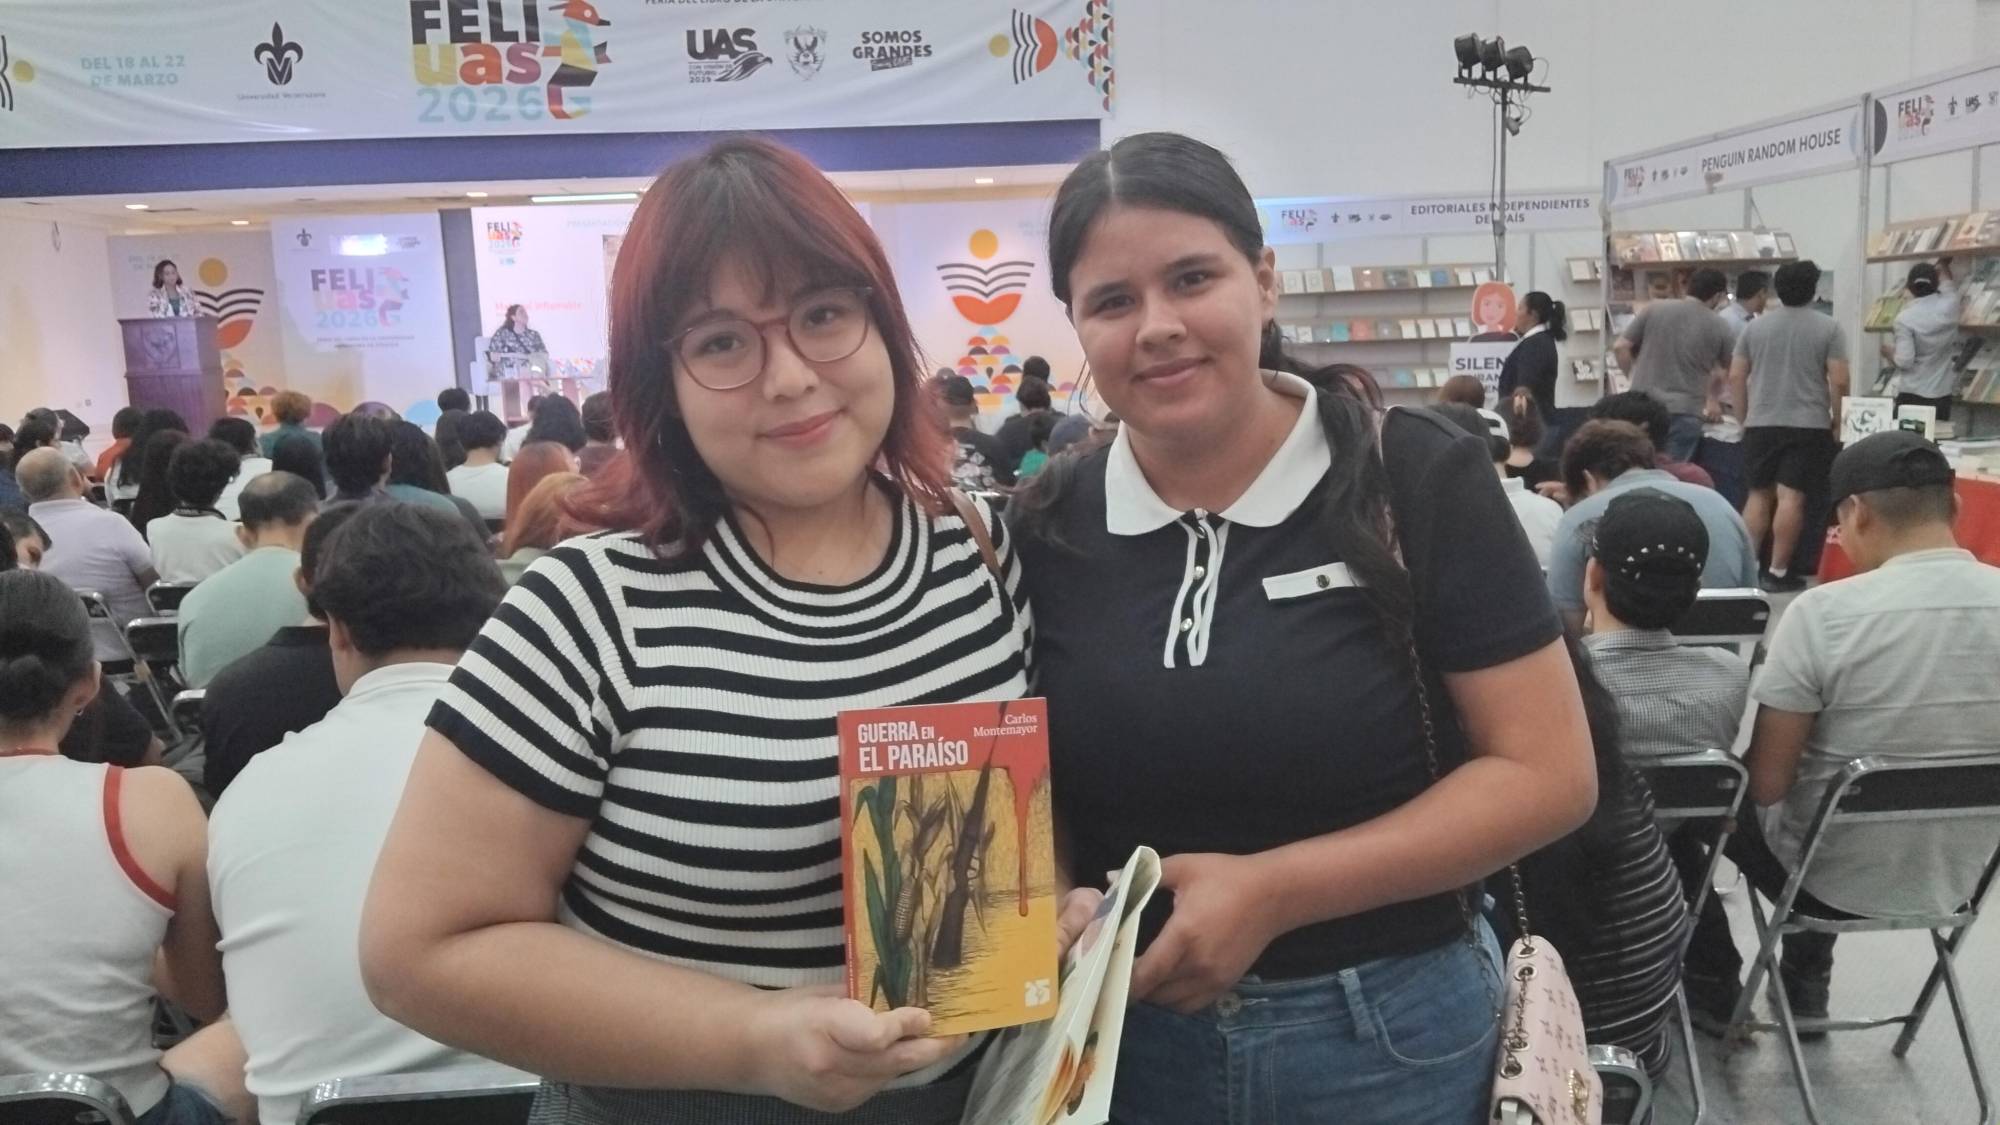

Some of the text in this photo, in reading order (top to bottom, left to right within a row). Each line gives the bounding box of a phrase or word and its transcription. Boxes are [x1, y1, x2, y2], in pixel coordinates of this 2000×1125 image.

[410, 0, 540, 45] FELI
[686, 28, 757, 60] UAS
[861, 30, 922, 44] SOMOS
[852, 44, 933, 59] GRANDES
[81, 54, 185, 70] DEL 18 AL 22
[412, 43, 542, 86] uas
[91, 73, 179, 88] DE MARZO
[415, 85, 545, 122] 2026
[1898, 97, 1922, 117] FELI
[1702, 150, 1745, 171] PENGUIN
[1747, 138, 1796, 163] RANDOM
[1799, 128, 1841, 152] HOUSE
[1411, 198, 1590, 215] EDITORIALES INDEPENDIENTES
[487, 222, 510, 232] FELI
[311, 268, 375, 291] FELI
[316, 310, 378, 329] 2026
[1456, 357, 1507, 370] SILEN
[1004, 713, 1038, 725] Carlos
[857, 721, 935, 744] GUERRA EN
[973, 725, 1038, 738] Montemayor
[859, 737, 969, 772] EL PARAÍSO
